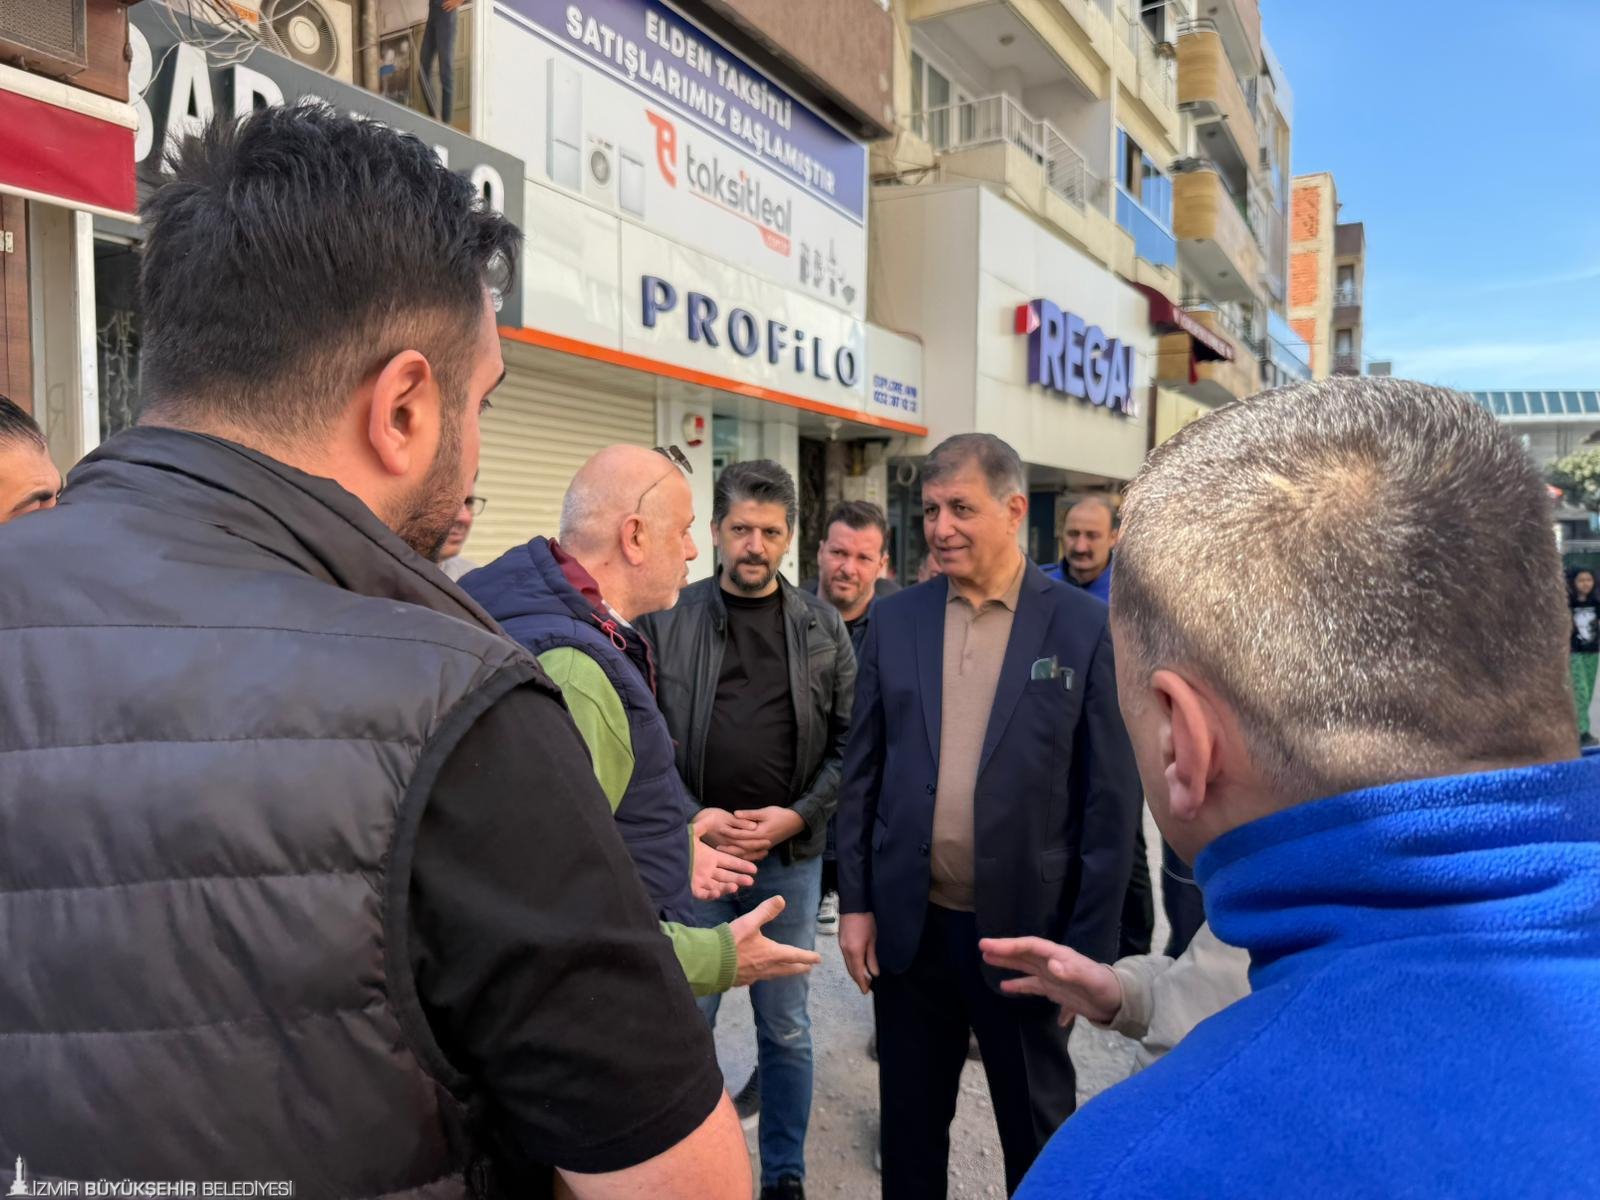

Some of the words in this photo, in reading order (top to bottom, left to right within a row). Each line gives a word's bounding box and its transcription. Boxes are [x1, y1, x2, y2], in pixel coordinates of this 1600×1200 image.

[566, 5, 726, 127] SATIŞLARIMIZ
[729, 105, 836, 196] BAŞLAMIŞTIR
[645, 10, 712, 78] ELDEN
[715, 57, 792, 130] TAKSİTLİ
